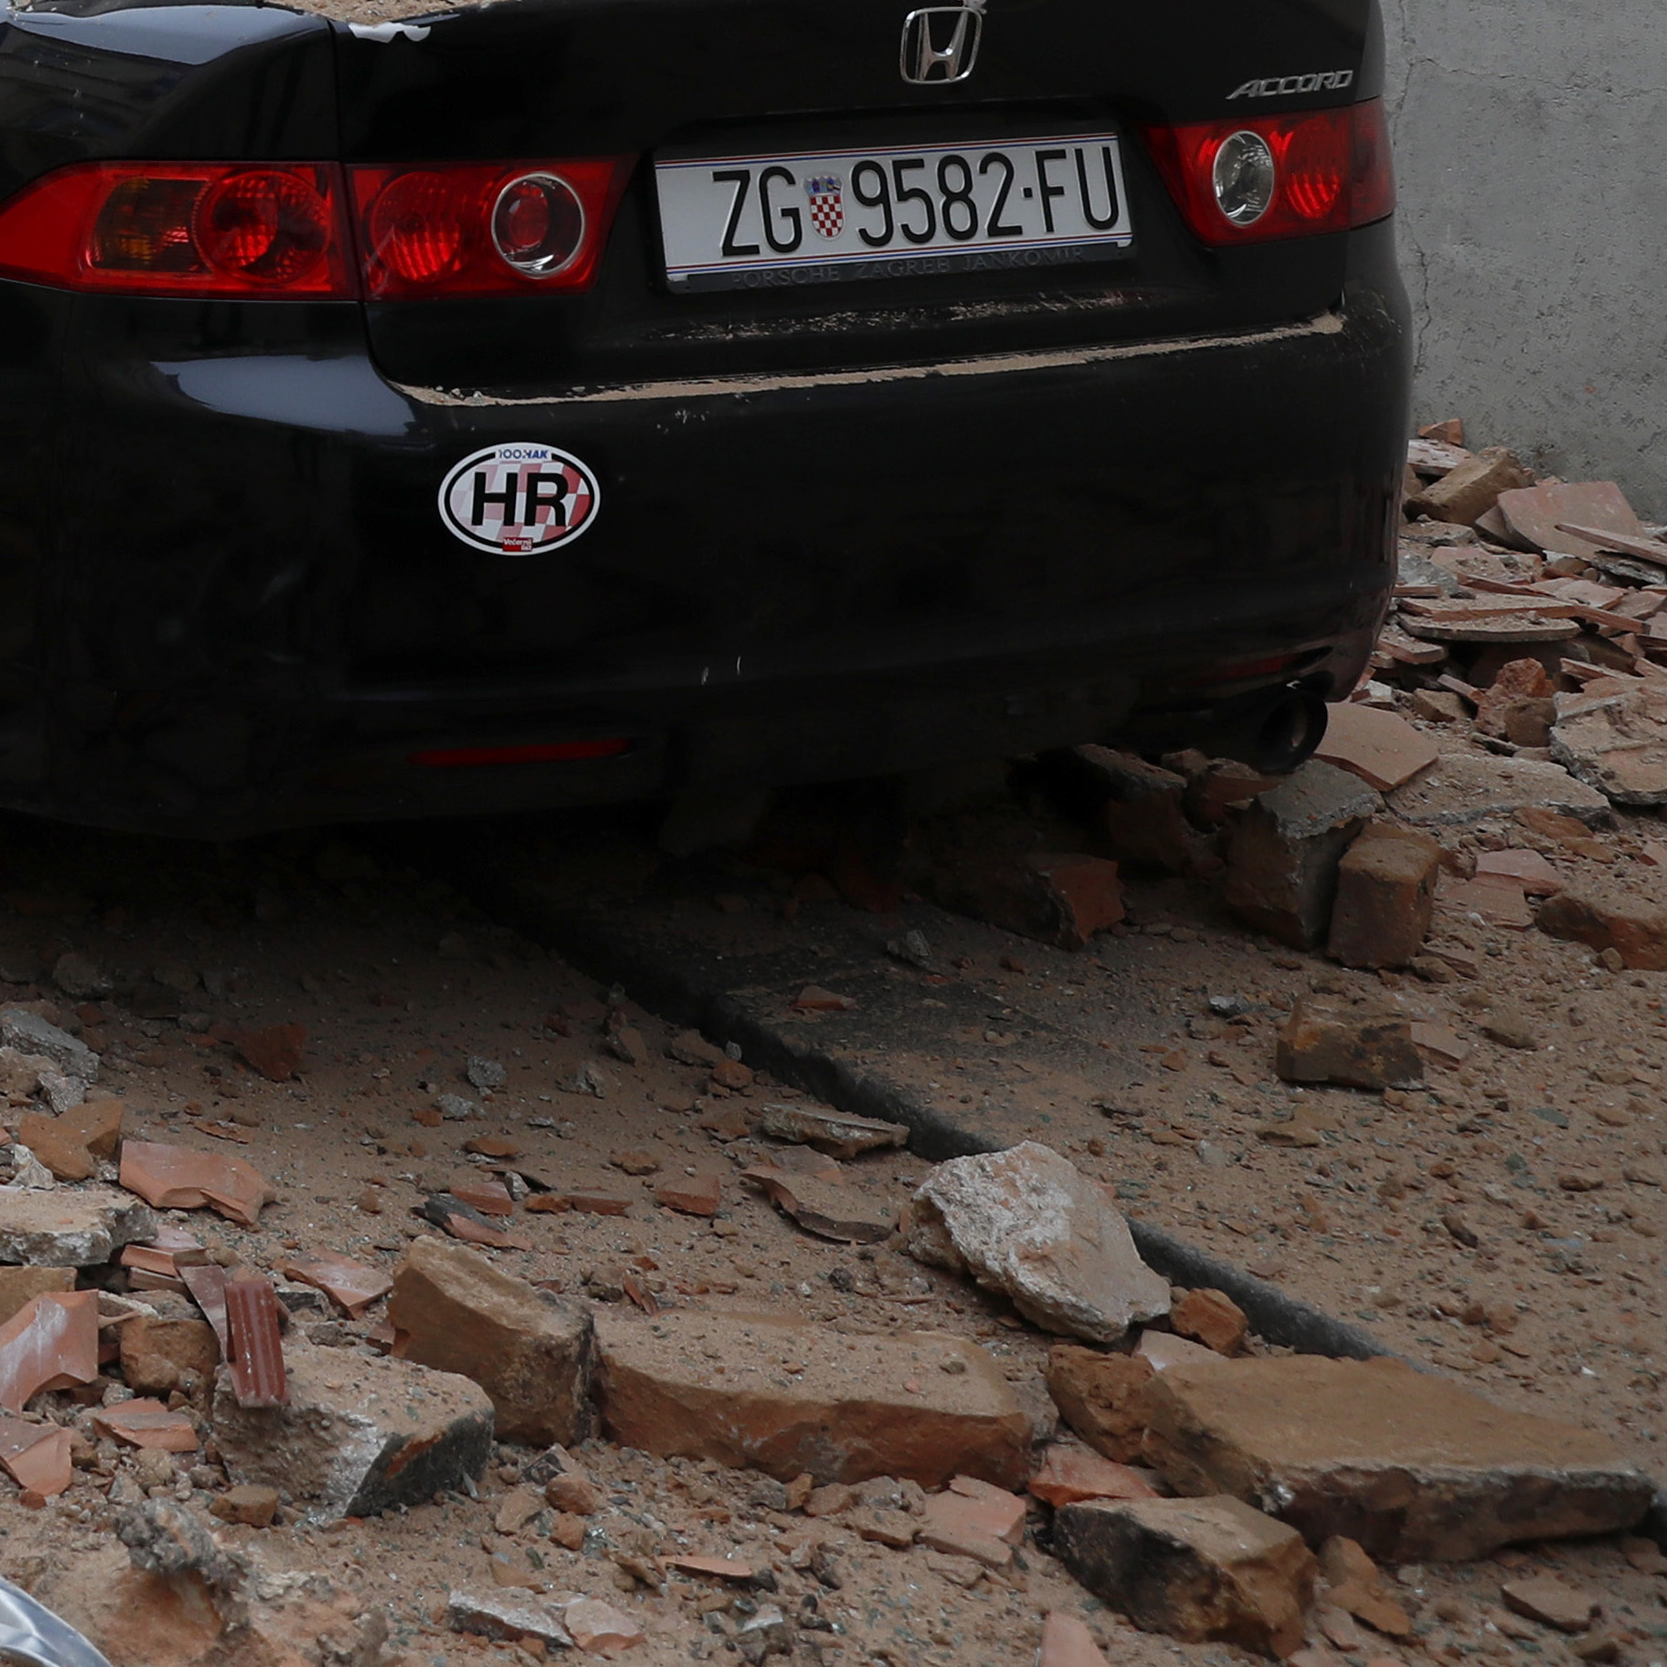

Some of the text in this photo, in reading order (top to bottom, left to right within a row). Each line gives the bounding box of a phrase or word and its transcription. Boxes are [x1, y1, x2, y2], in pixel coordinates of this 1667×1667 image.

[1226, 70, 1353, 99] ACCORD
[712, 165, 803, 257] ZG
[731, 246, 1086, 289] PORSCHE ZAGREB JANKOMIR
[471, 471, 570, 526] HR
